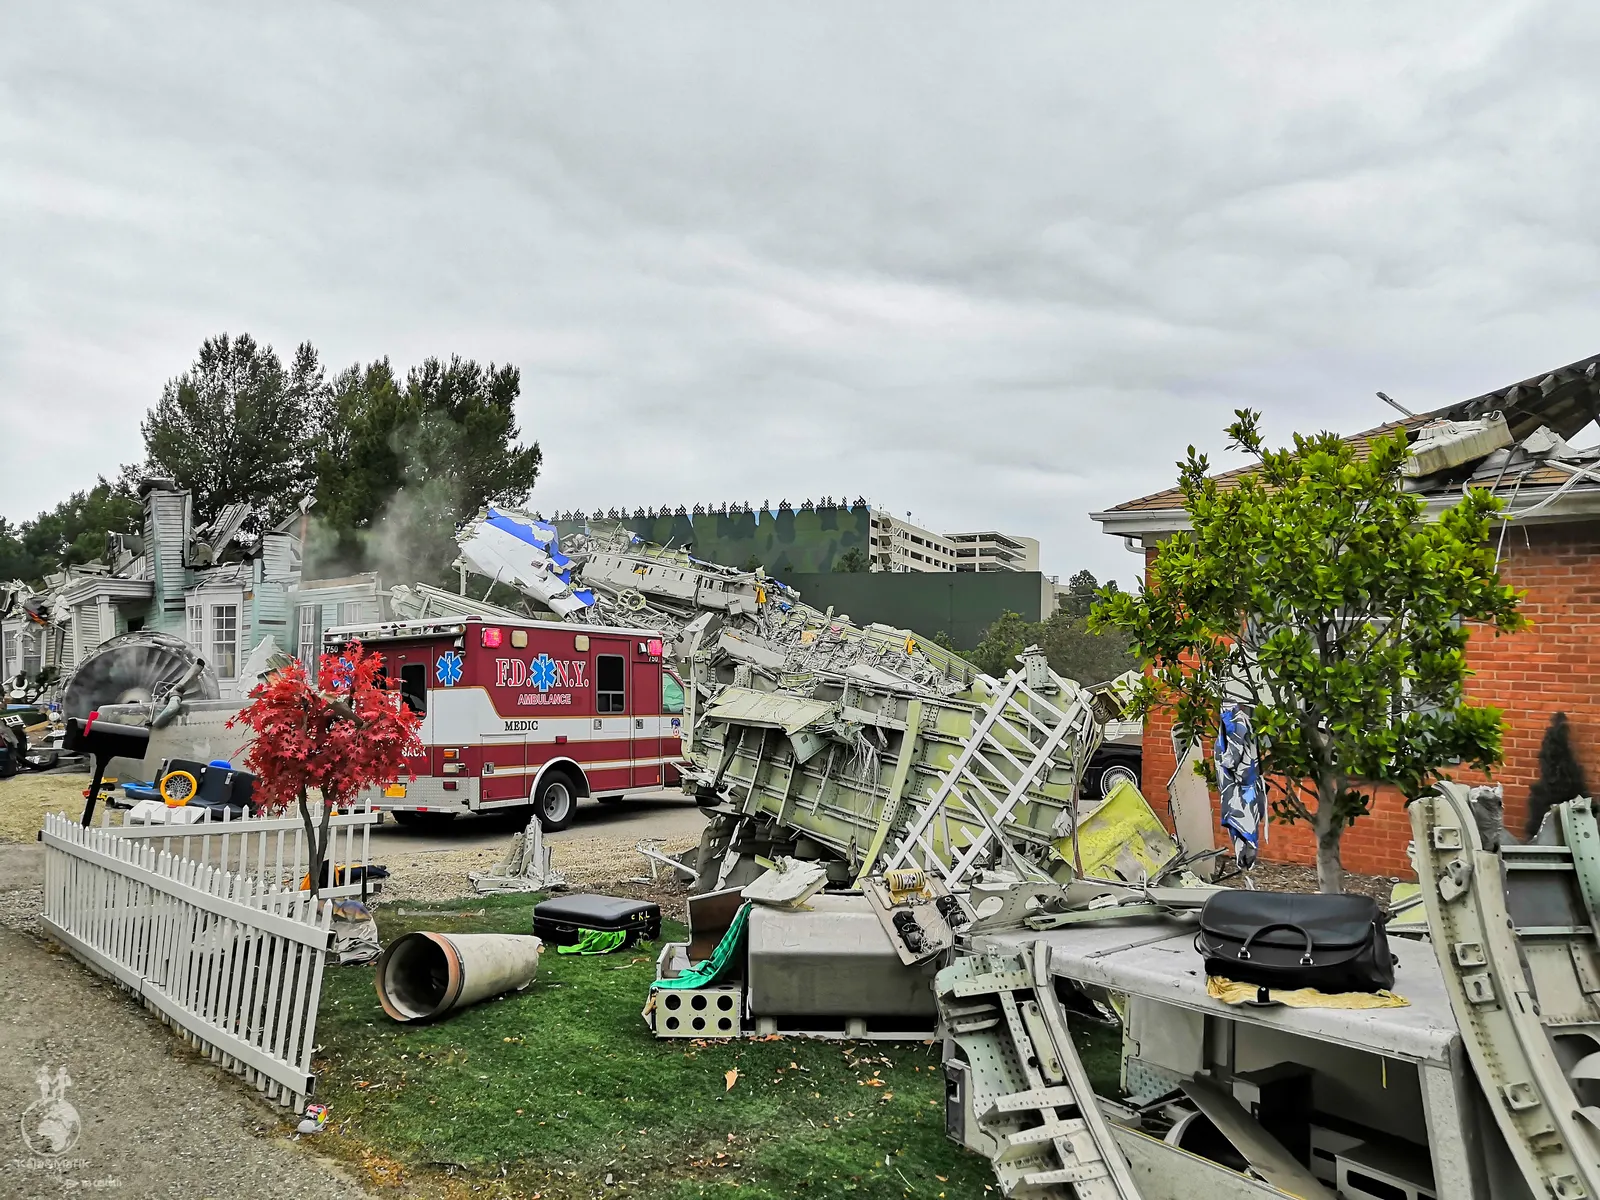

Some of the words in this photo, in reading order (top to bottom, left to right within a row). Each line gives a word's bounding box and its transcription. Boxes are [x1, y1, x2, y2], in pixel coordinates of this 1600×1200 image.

[325, 645, 339, 654] 750
[517, 693, 572, 706] AMBULANCE
[504, 720, 539, 732] MEDIC
